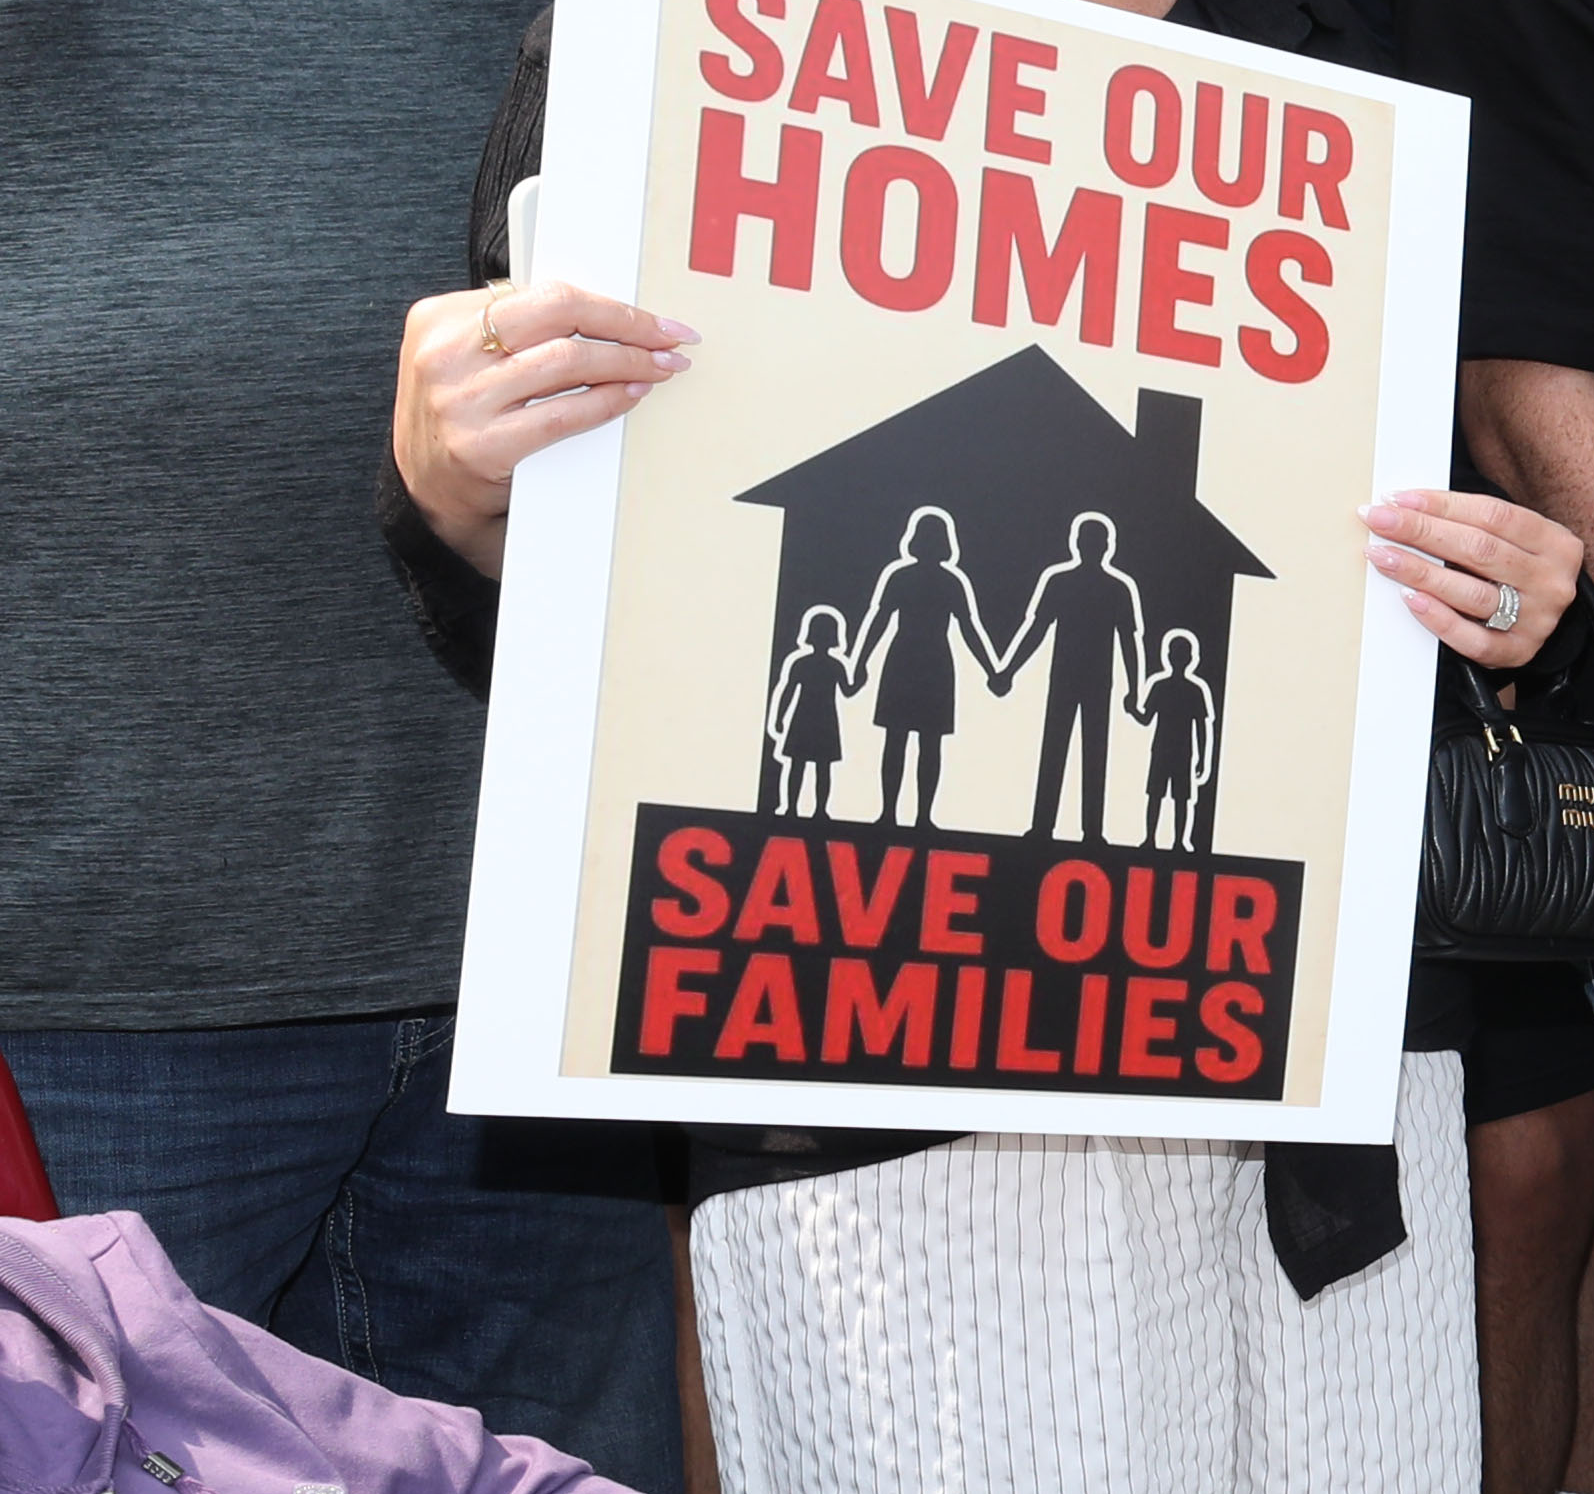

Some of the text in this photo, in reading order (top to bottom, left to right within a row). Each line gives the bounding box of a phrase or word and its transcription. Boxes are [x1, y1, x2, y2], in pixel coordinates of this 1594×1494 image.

[1104, 64, 1355, 232] OUR
[688, 106, 1335, 386] HOMES
[651, 825, 1279, 976] SAVE OUR
[638, 945, 1267, 1085] FAMILIES
